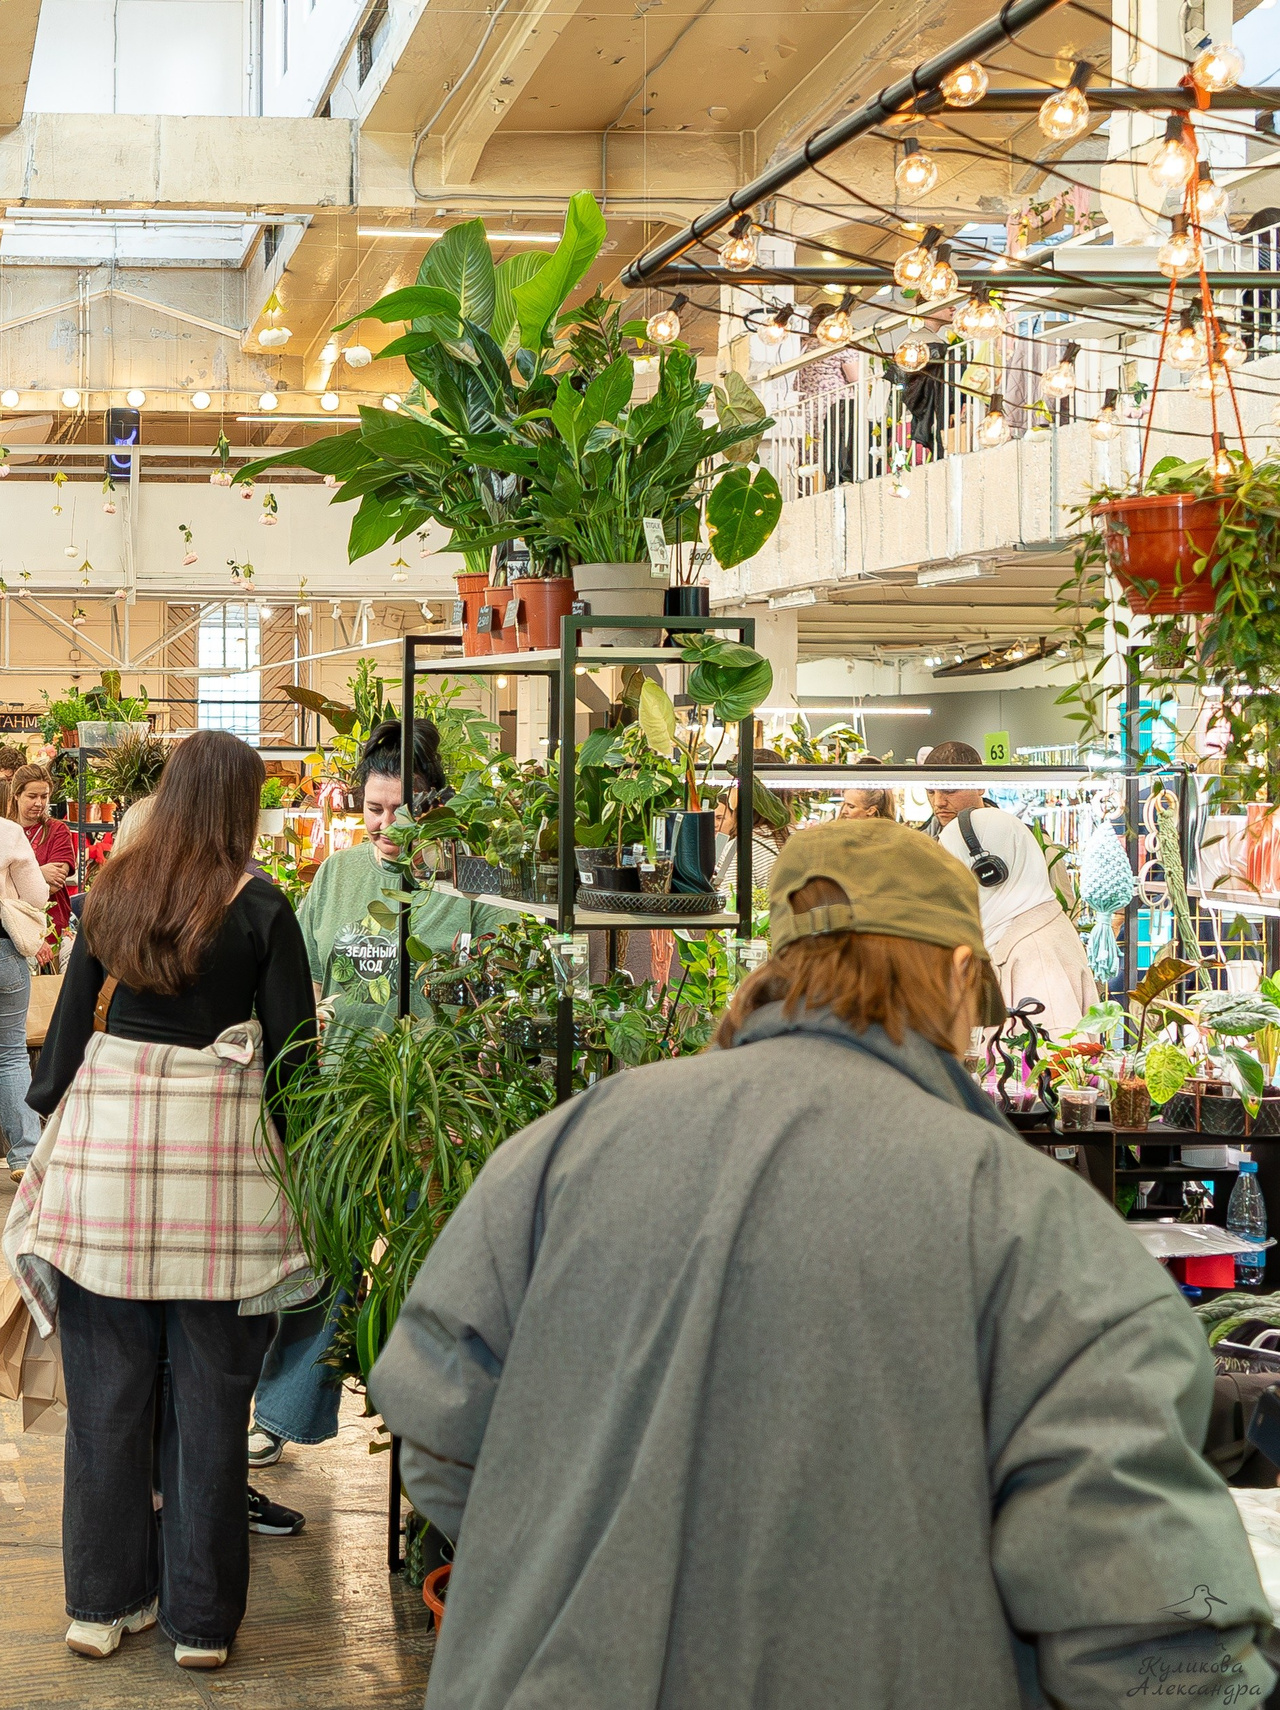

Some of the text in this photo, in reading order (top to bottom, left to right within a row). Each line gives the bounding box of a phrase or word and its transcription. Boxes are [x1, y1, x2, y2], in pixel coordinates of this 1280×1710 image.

[990, 744, 1005, 761] 63
[345, 943, 397, 958] ЗЕЛЁНЫЙ
[359, 960, 383, 973] КОД
